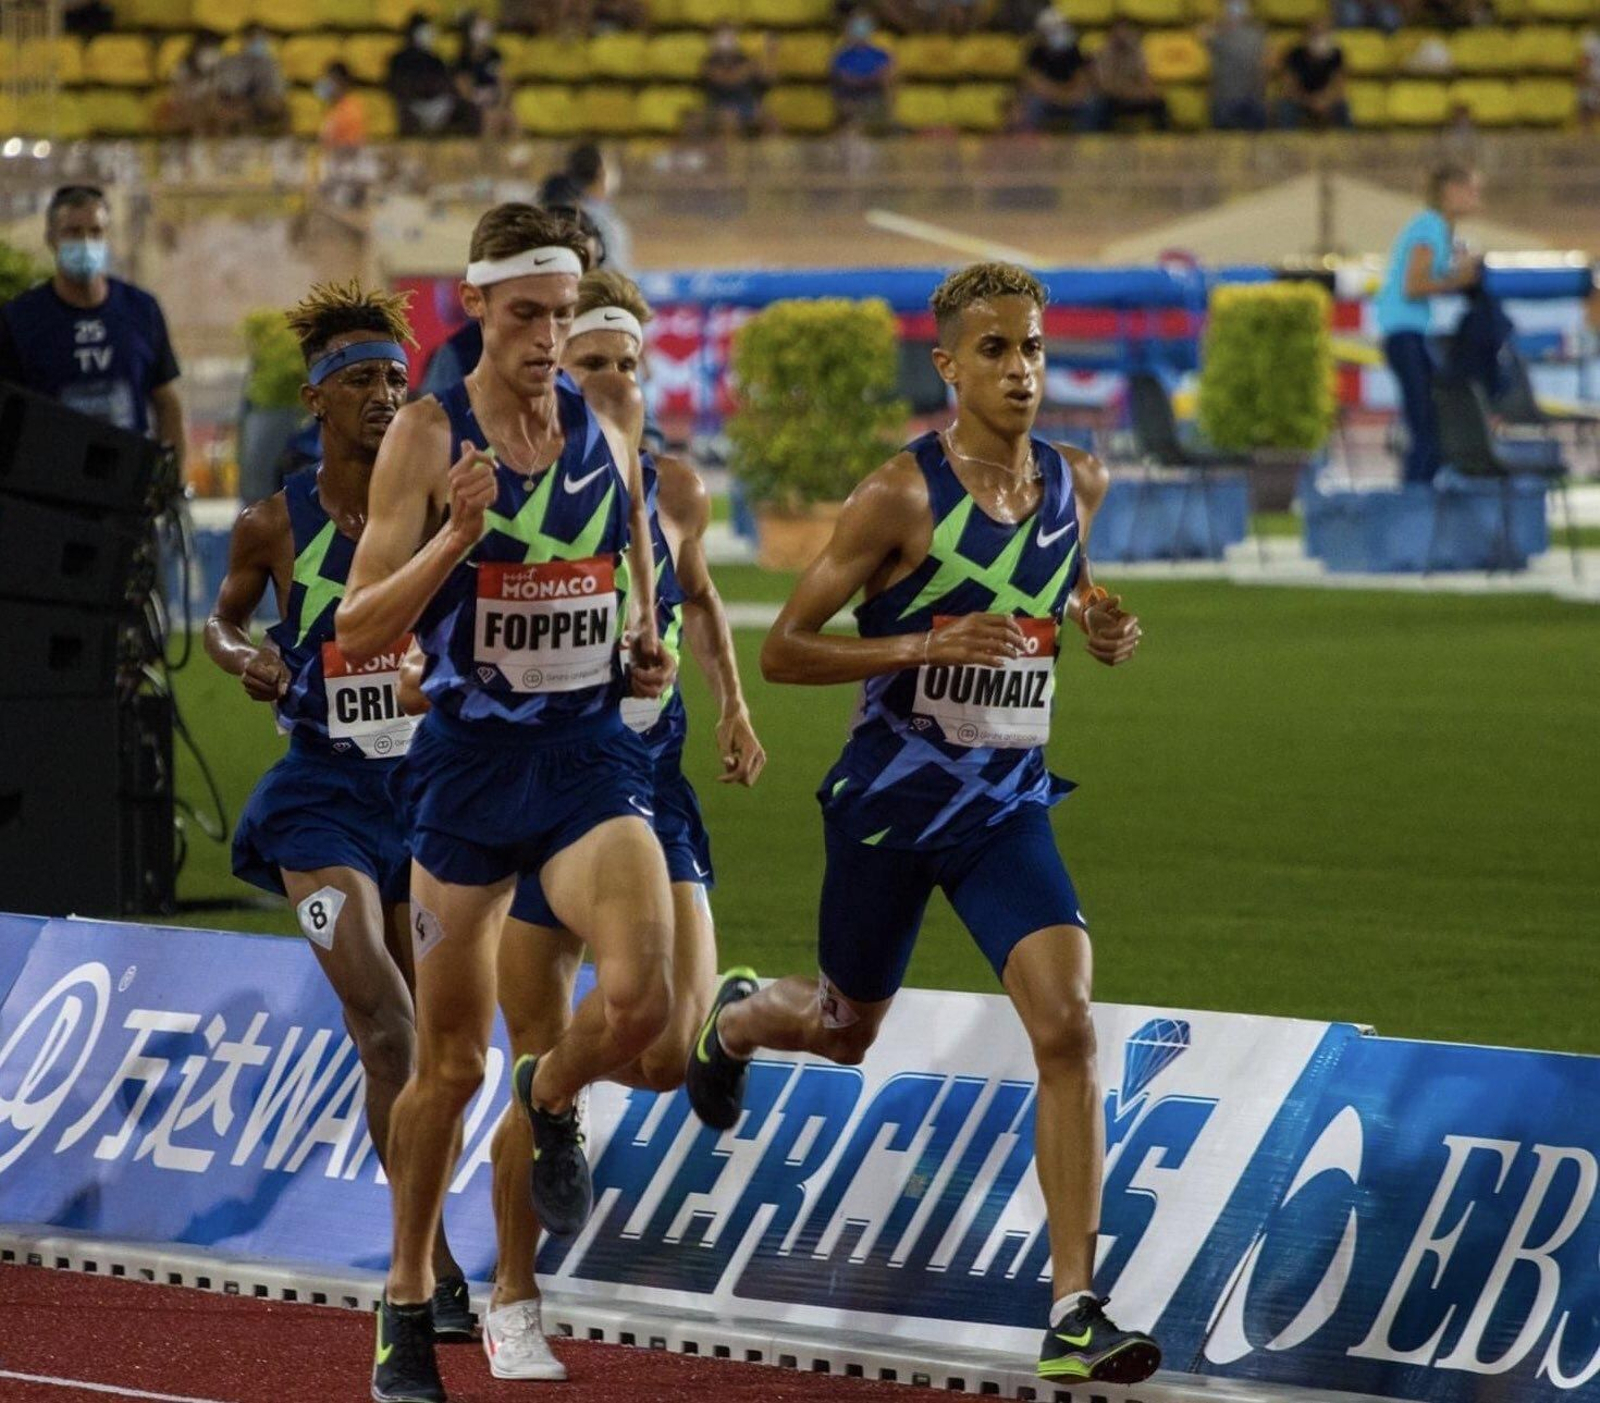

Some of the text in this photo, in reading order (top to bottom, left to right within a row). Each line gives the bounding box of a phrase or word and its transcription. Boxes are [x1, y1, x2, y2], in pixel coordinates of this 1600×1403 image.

[73, 346, 114, 373] TV
[501, 575, 597, 599] MONACO
[484, 607, 609, 651] FOPPEN
[336, 684, 405, 724] CRI
[924, 664, 1049, 709] OUMAIZ
[309, 900, 328, 931] 8
